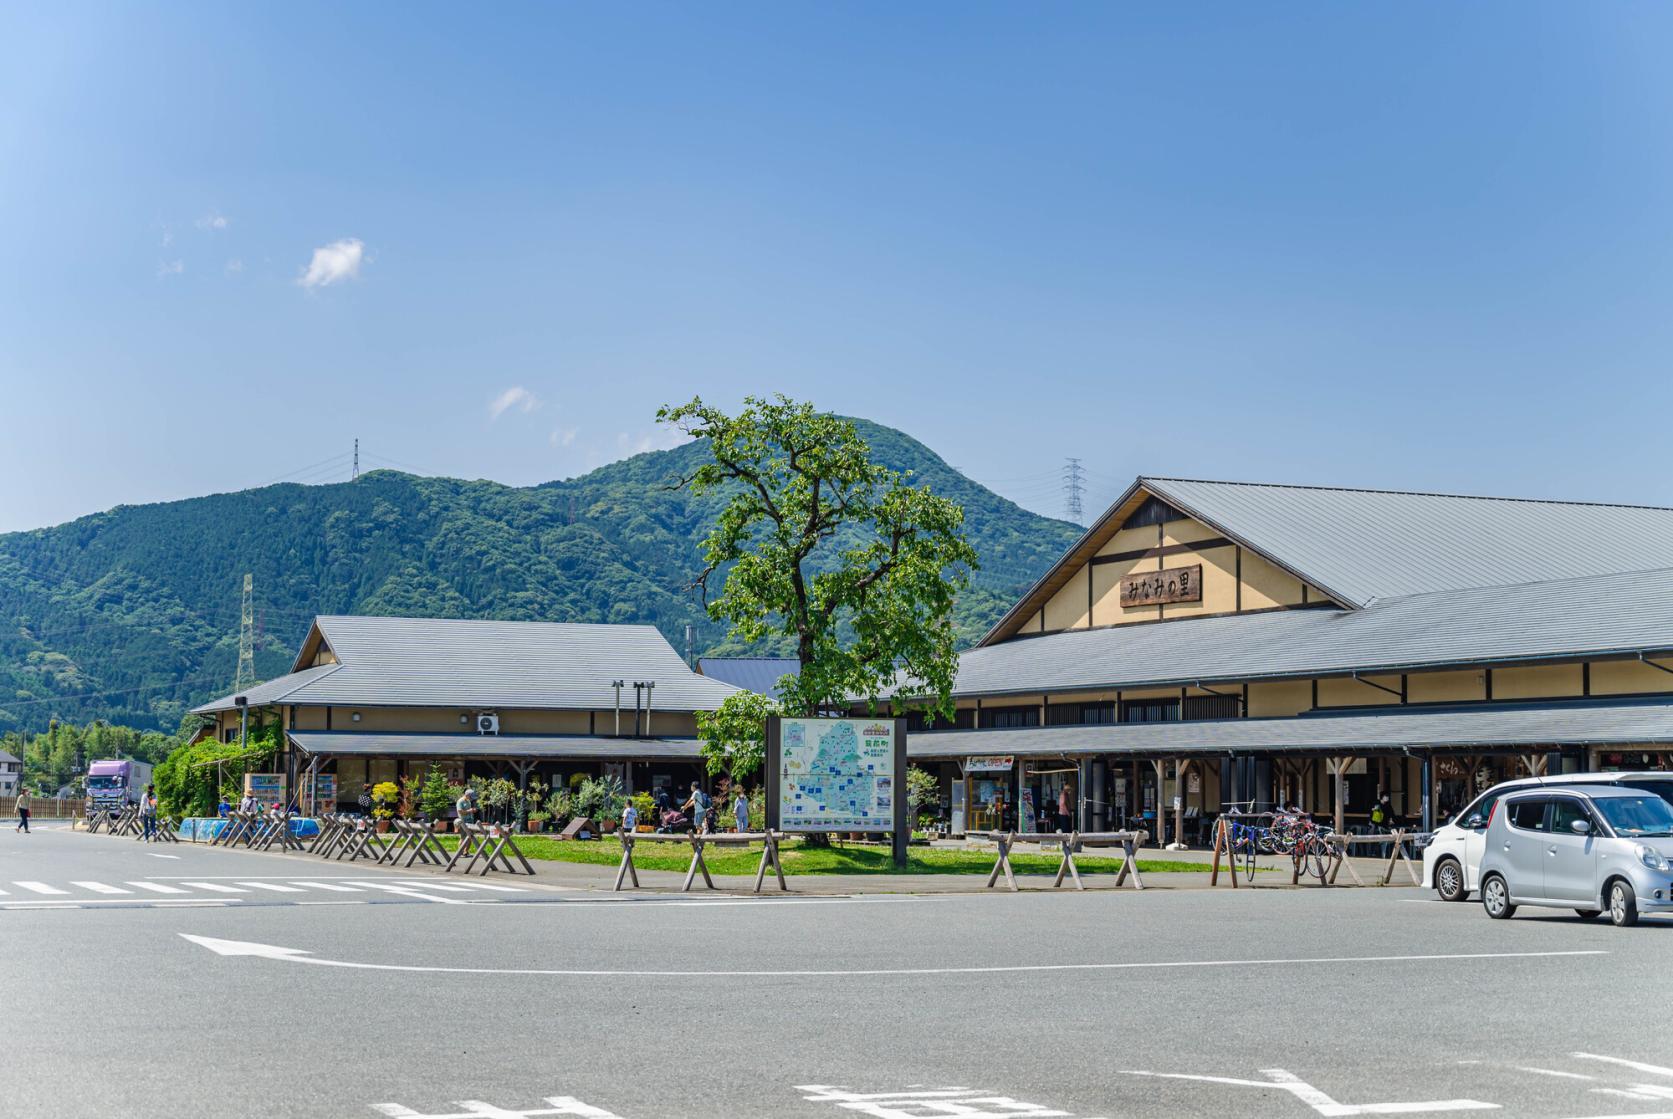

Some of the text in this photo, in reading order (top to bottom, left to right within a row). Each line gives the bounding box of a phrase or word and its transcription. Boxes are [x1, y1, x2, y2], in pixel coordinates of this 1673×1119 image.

[1128, 571, 1190, 600] みなみの里
